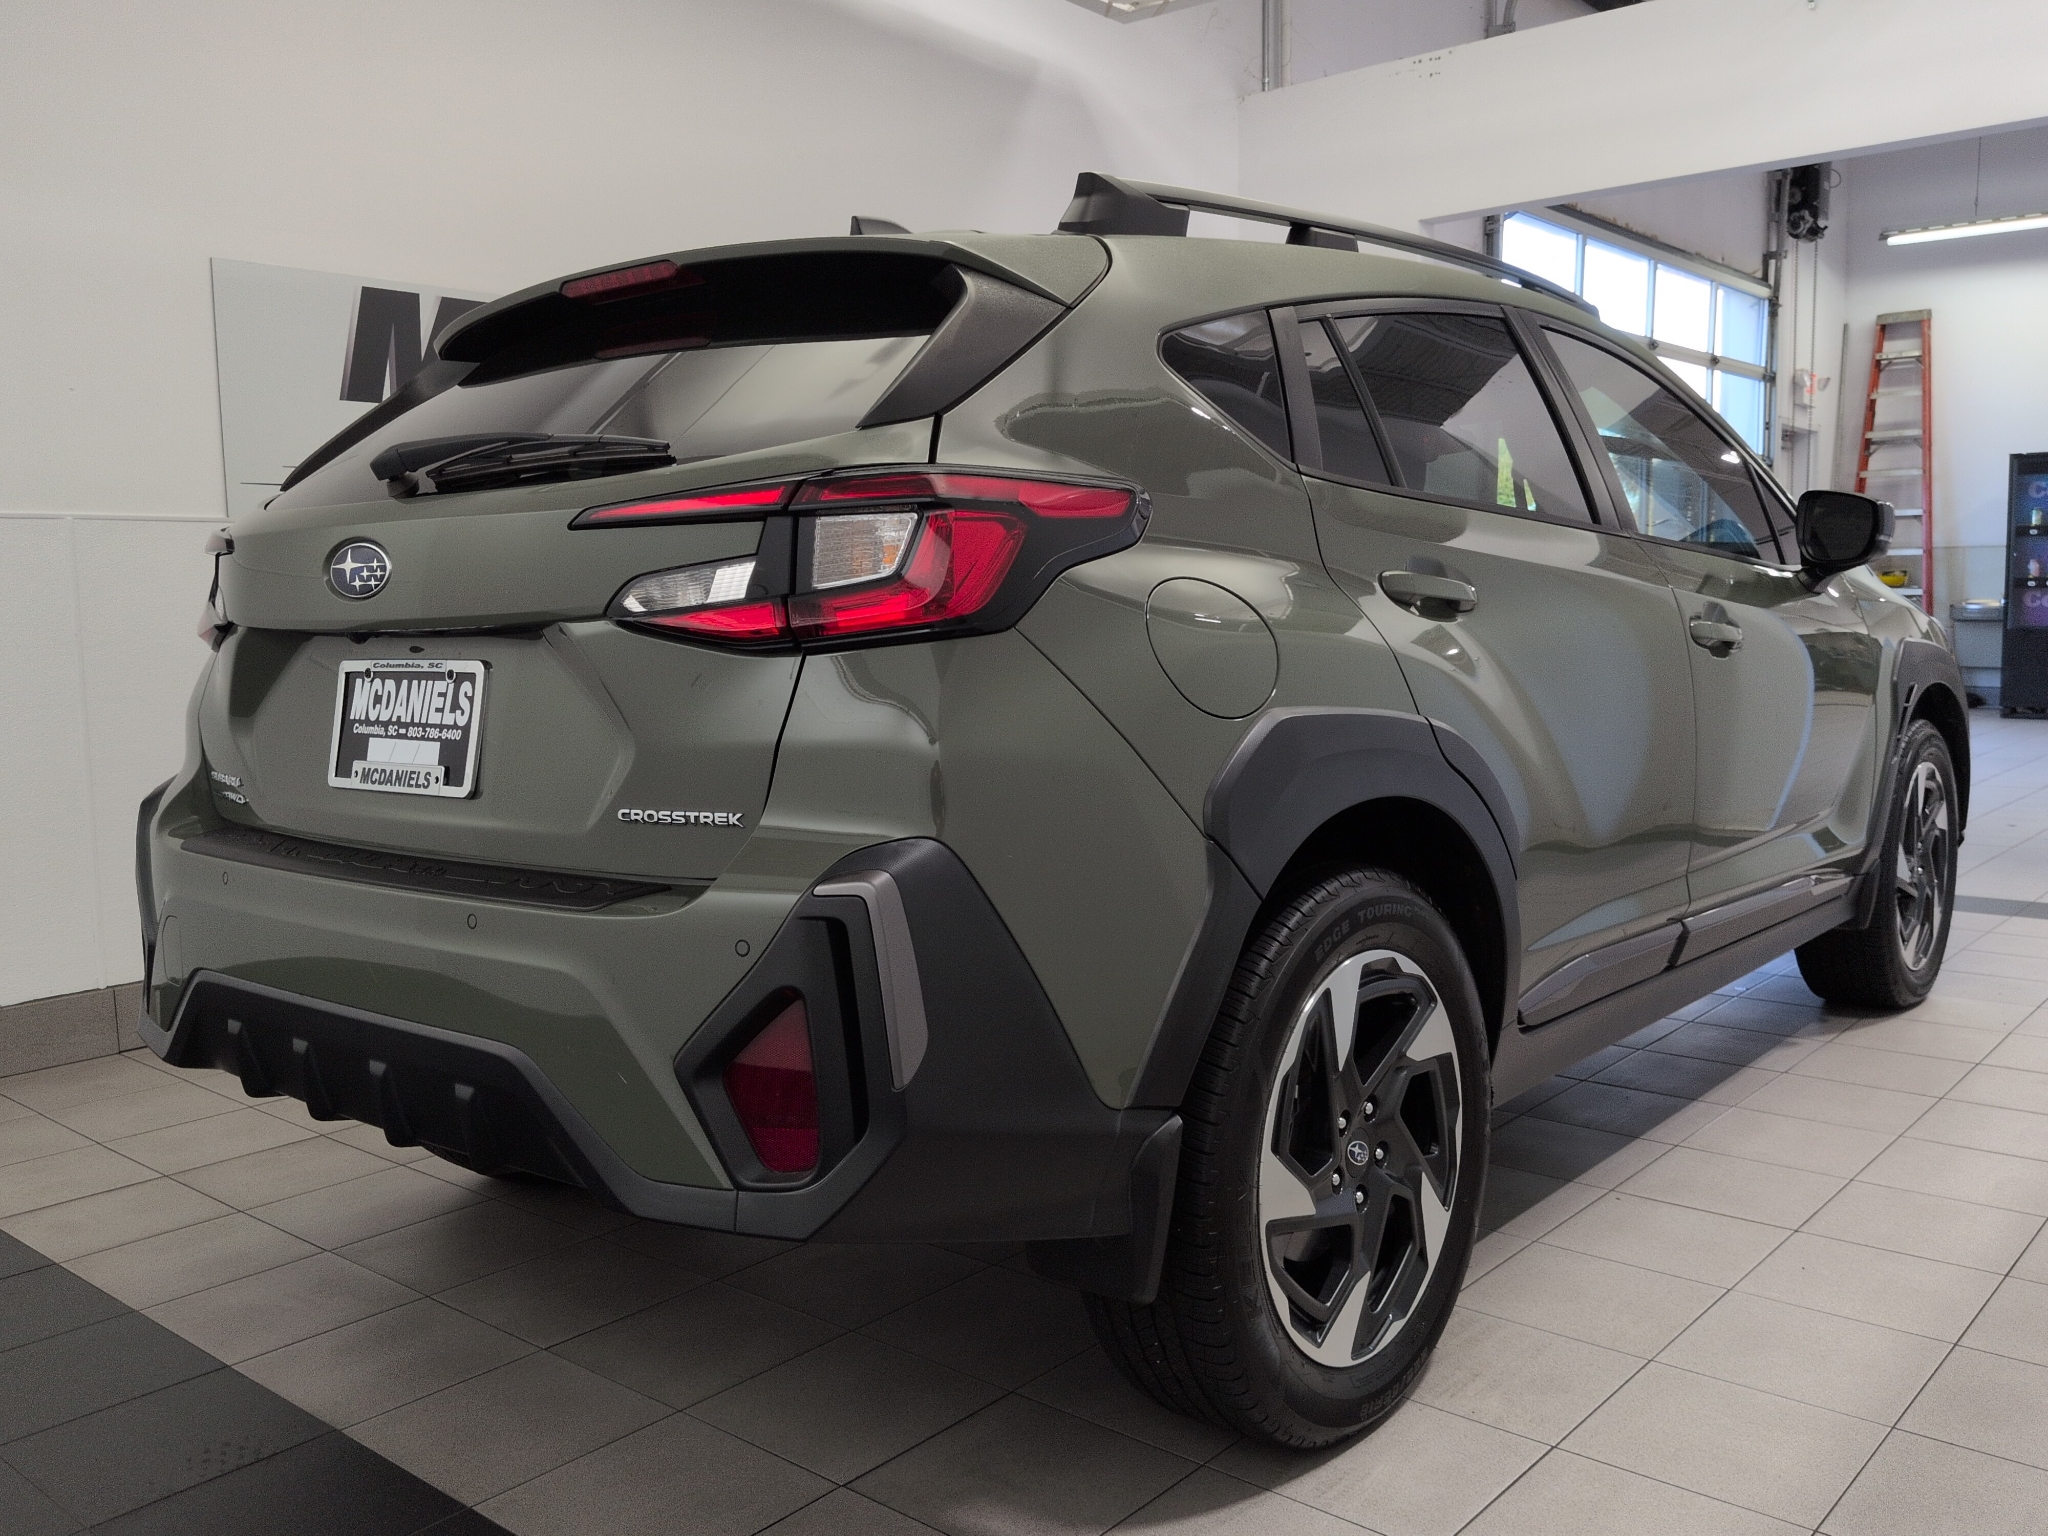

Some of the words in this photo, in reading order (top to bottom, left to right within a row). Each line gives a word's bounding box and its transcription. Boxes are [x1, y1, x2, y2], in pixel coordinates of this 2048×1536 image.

[350, 678, 473, 727] MCDANIELS
[353, 723, 386, 737] Columbia,
[387, 725, 399, 736] SC
[407, 726, 462, 740] 803-786-6400
[359, 767, 432, 789] MCDANIELS
[617, 808, 745, 828] CROSSTREK
[1315, 919, 1350, 962] EDGE
[1358, 903, 1413, 922] TOURING
